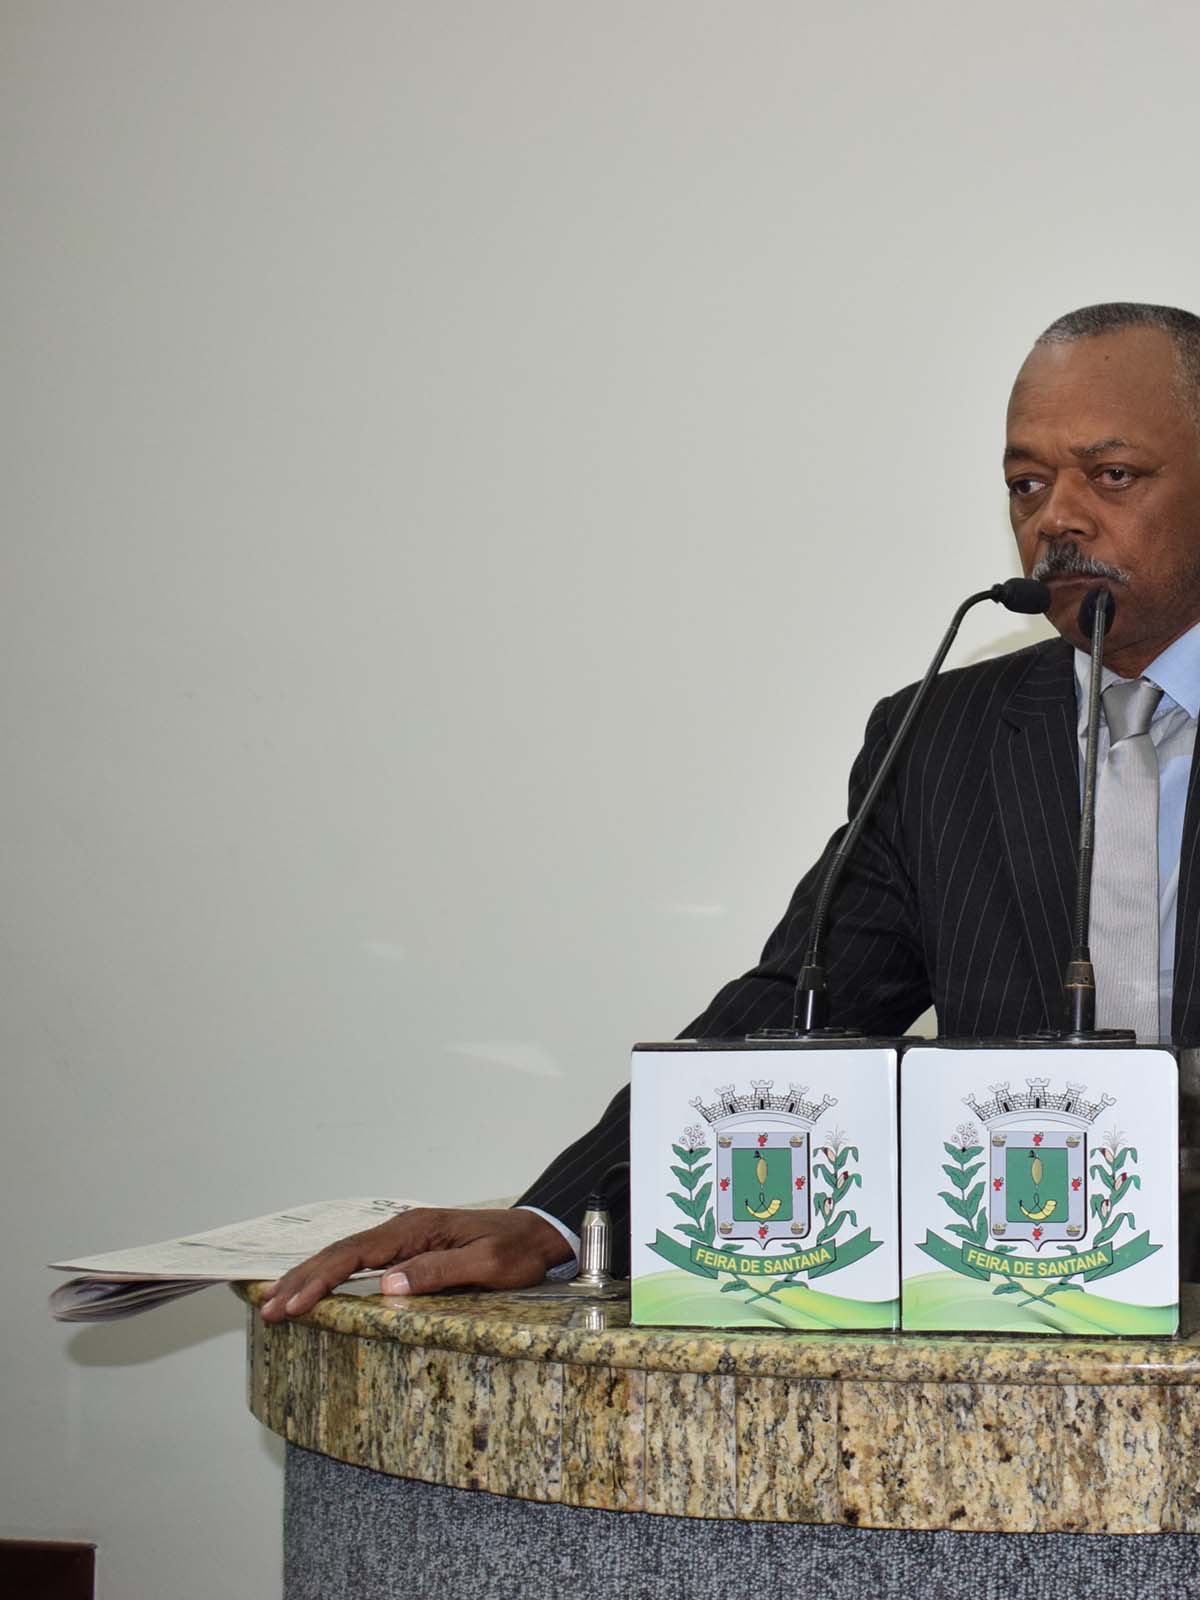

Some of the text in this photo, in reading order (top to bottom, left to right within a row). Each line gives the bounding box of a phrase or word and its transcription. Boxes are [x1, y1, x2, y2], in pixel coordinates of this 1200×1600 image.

[695, 1248, 832, 1274] FEIRA DE SANTANA
[967, 1250, 1108, 1276] FEIRA DE SANTANA
